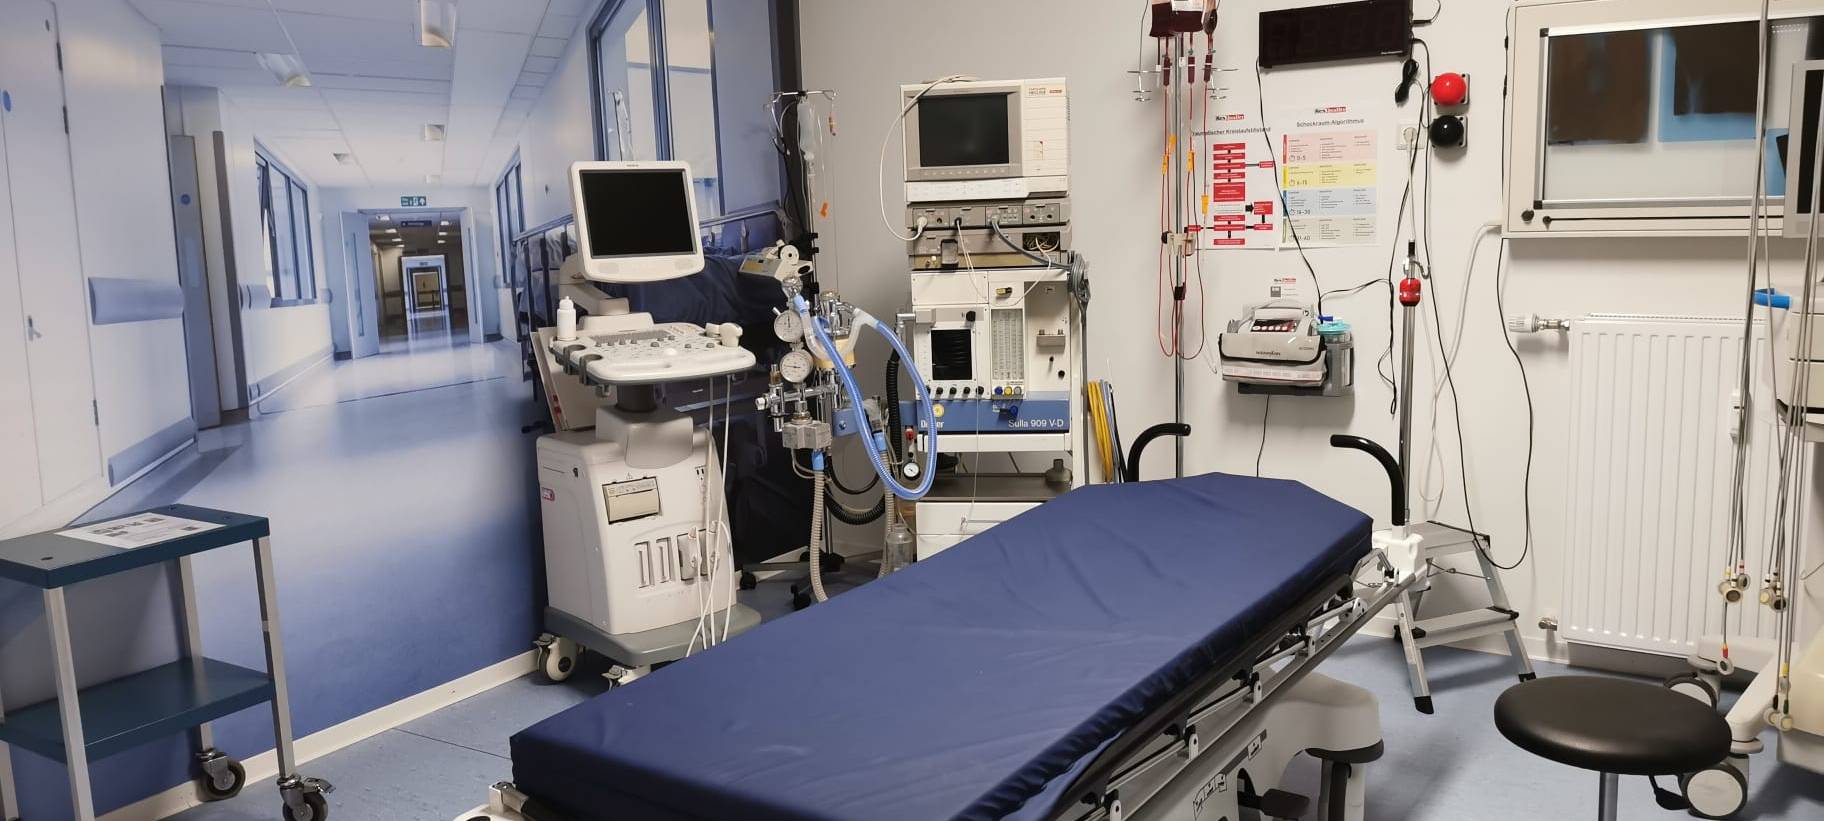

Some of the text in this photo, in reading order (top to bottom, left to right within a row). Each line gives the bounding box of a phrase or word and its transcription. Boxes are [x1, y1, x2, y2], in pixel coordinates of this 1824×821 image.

[920, 419, 945, 428] Drer
[1008, 419, 1029, 428] Sulla
[1030, 419, 1047, 428] 909
